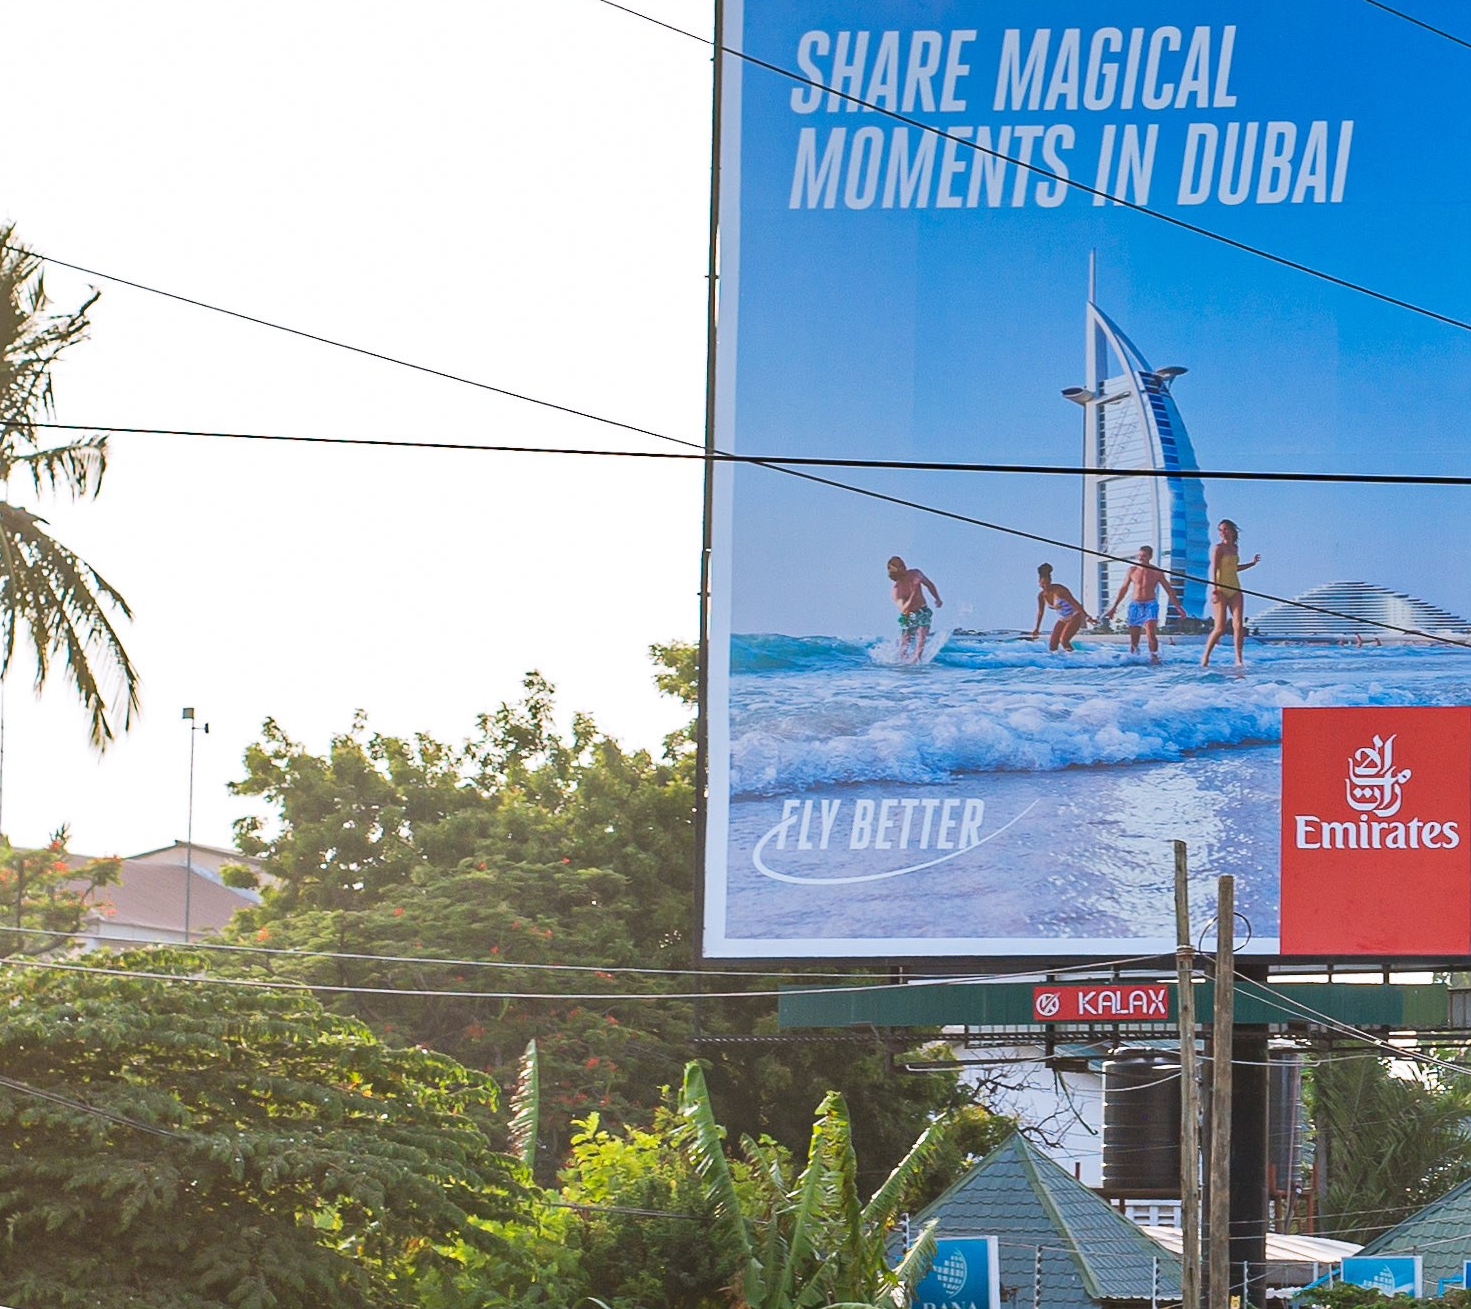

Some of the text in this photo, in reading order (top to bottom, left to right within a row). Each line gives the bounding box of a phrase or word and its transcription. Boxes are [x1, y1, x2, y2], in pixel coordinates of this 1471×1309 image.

[790, 25, 1238, 114] SHARE MAGICAL
[789, 120, 1354, 209] MOMENTS IN DUBAI
[775, 798, 986, 851] FLY BETTER
[1295, 813, 1460, 851] Emirates
[1077, 990, 1166, 1017] KALAX
